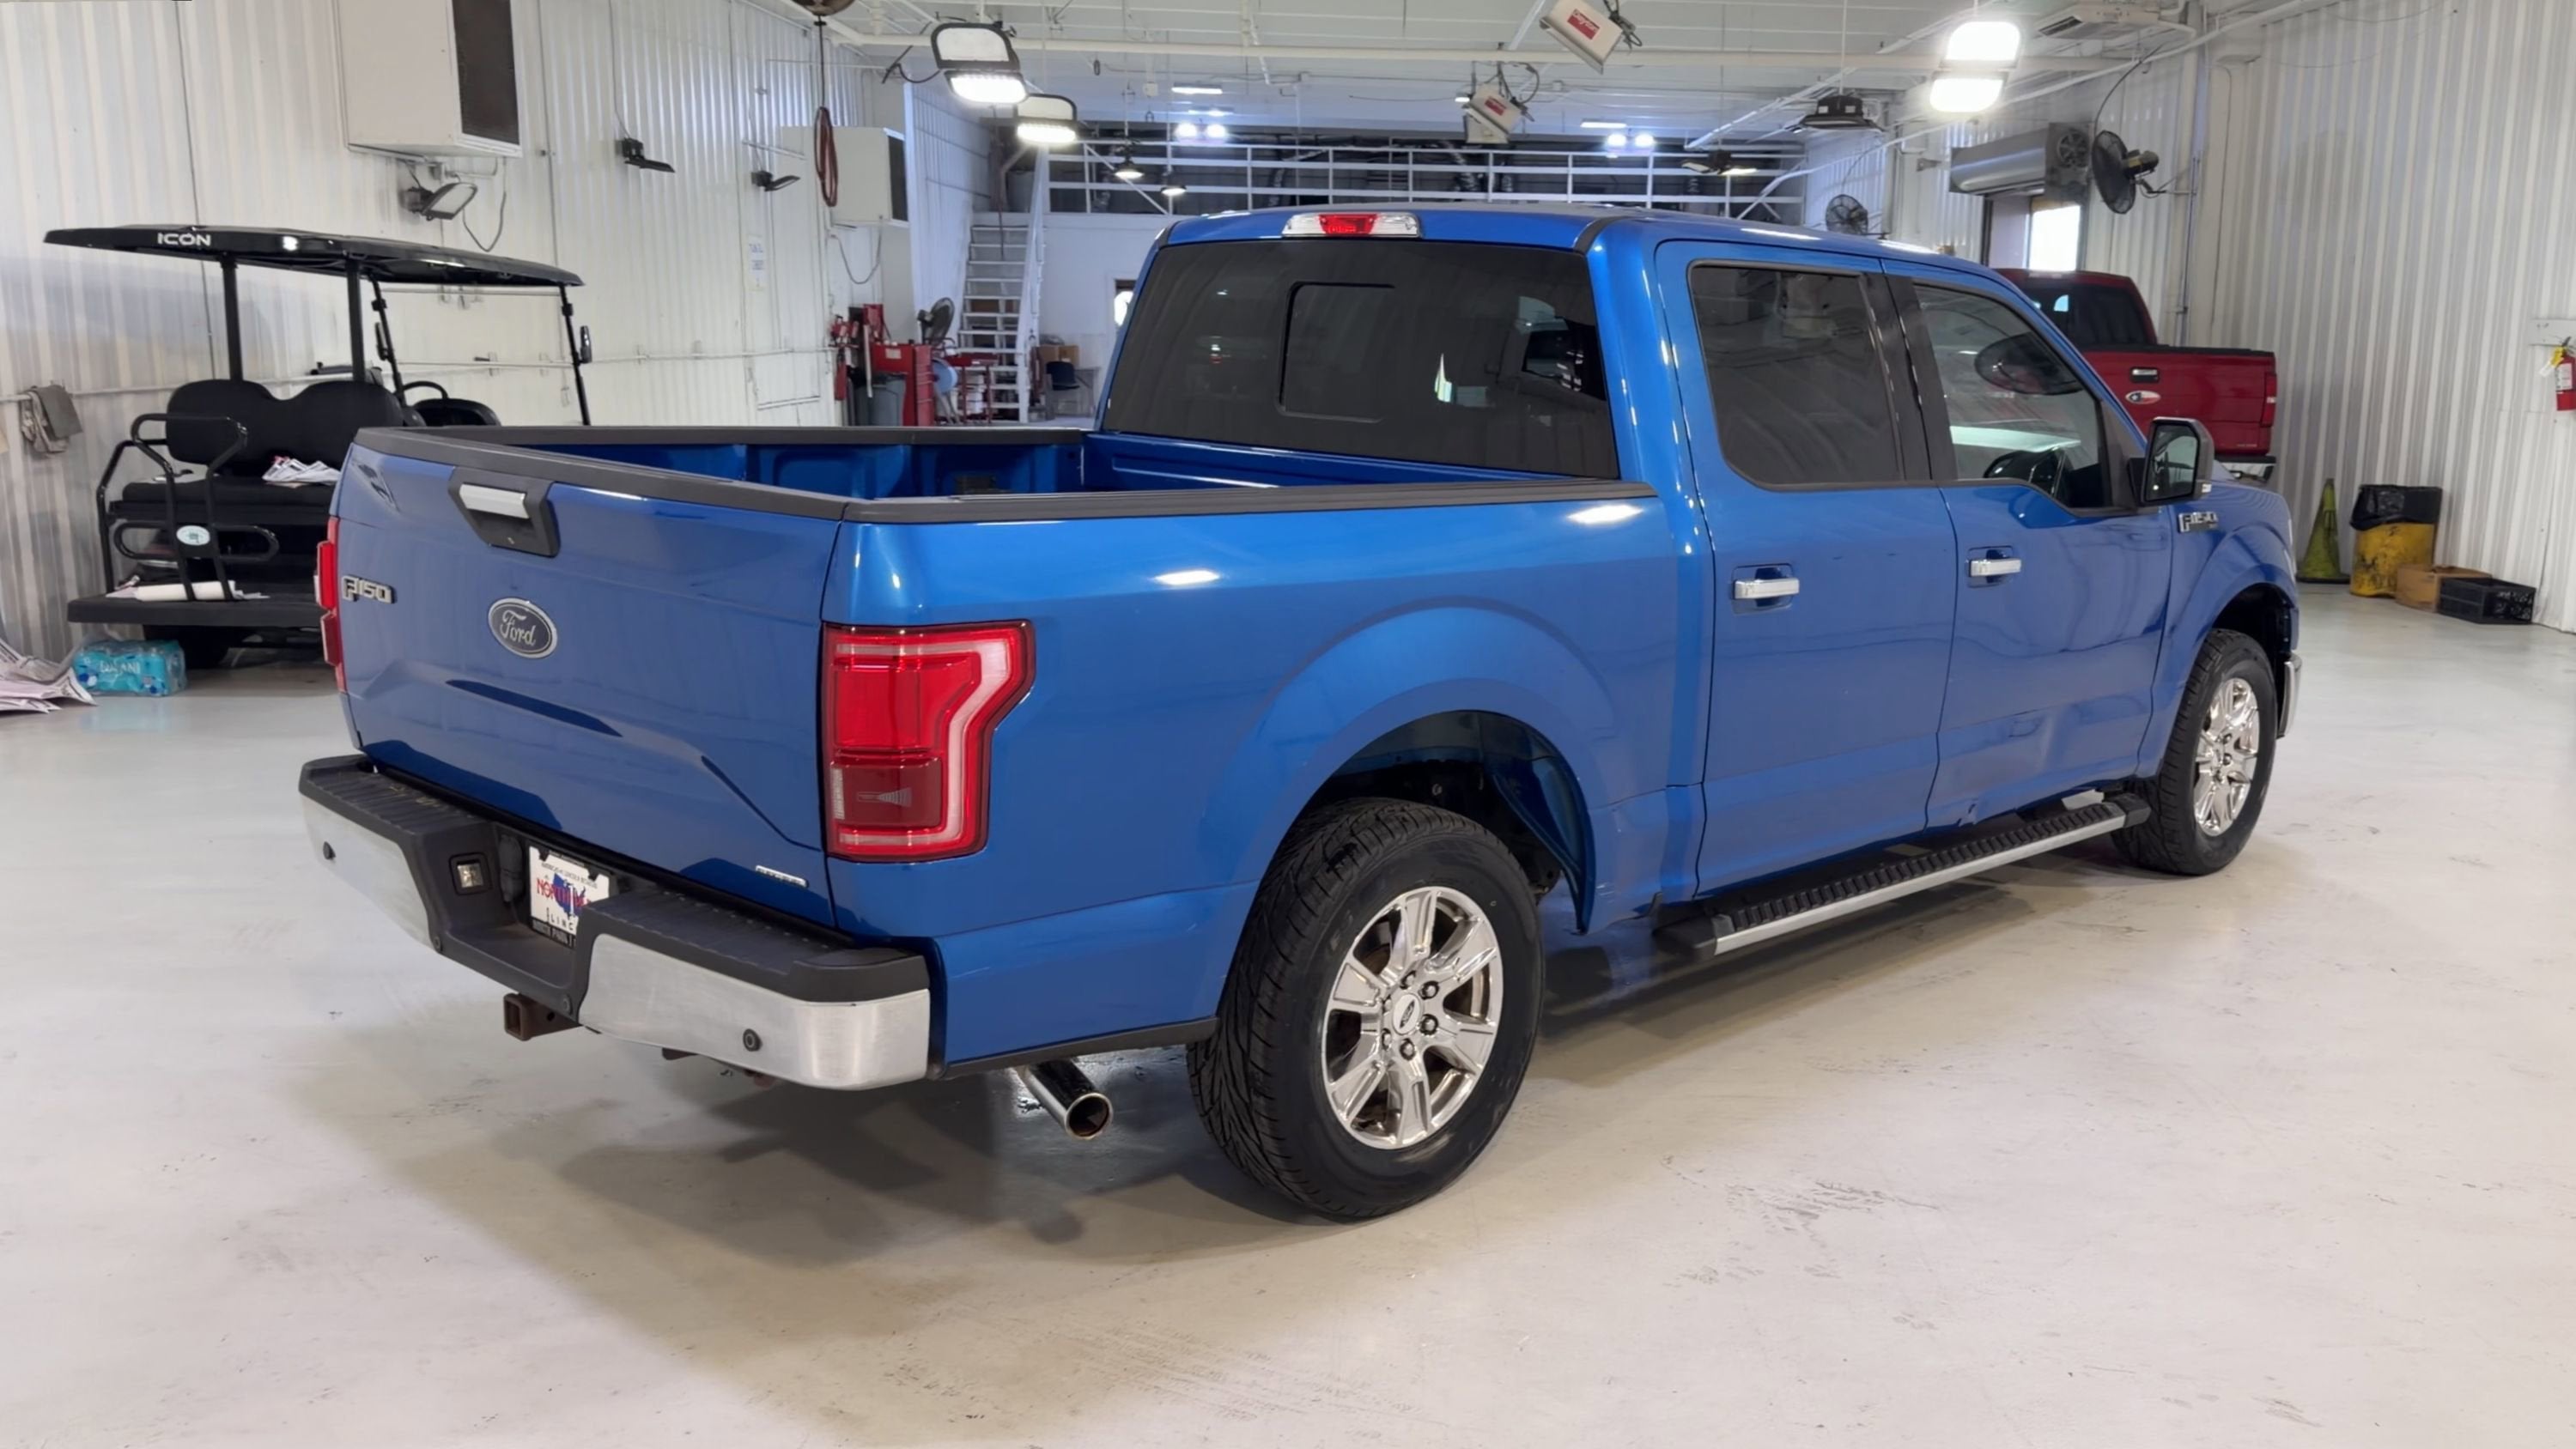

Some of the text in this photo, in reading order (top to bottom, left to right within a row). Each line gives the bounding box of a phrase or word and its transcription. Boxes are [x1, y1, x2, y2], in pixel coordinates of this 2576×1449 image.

[157, 232, 211, 246] ICON
[342, 575, 392, 604] F150
[500, 609, 537, 646] Ford
